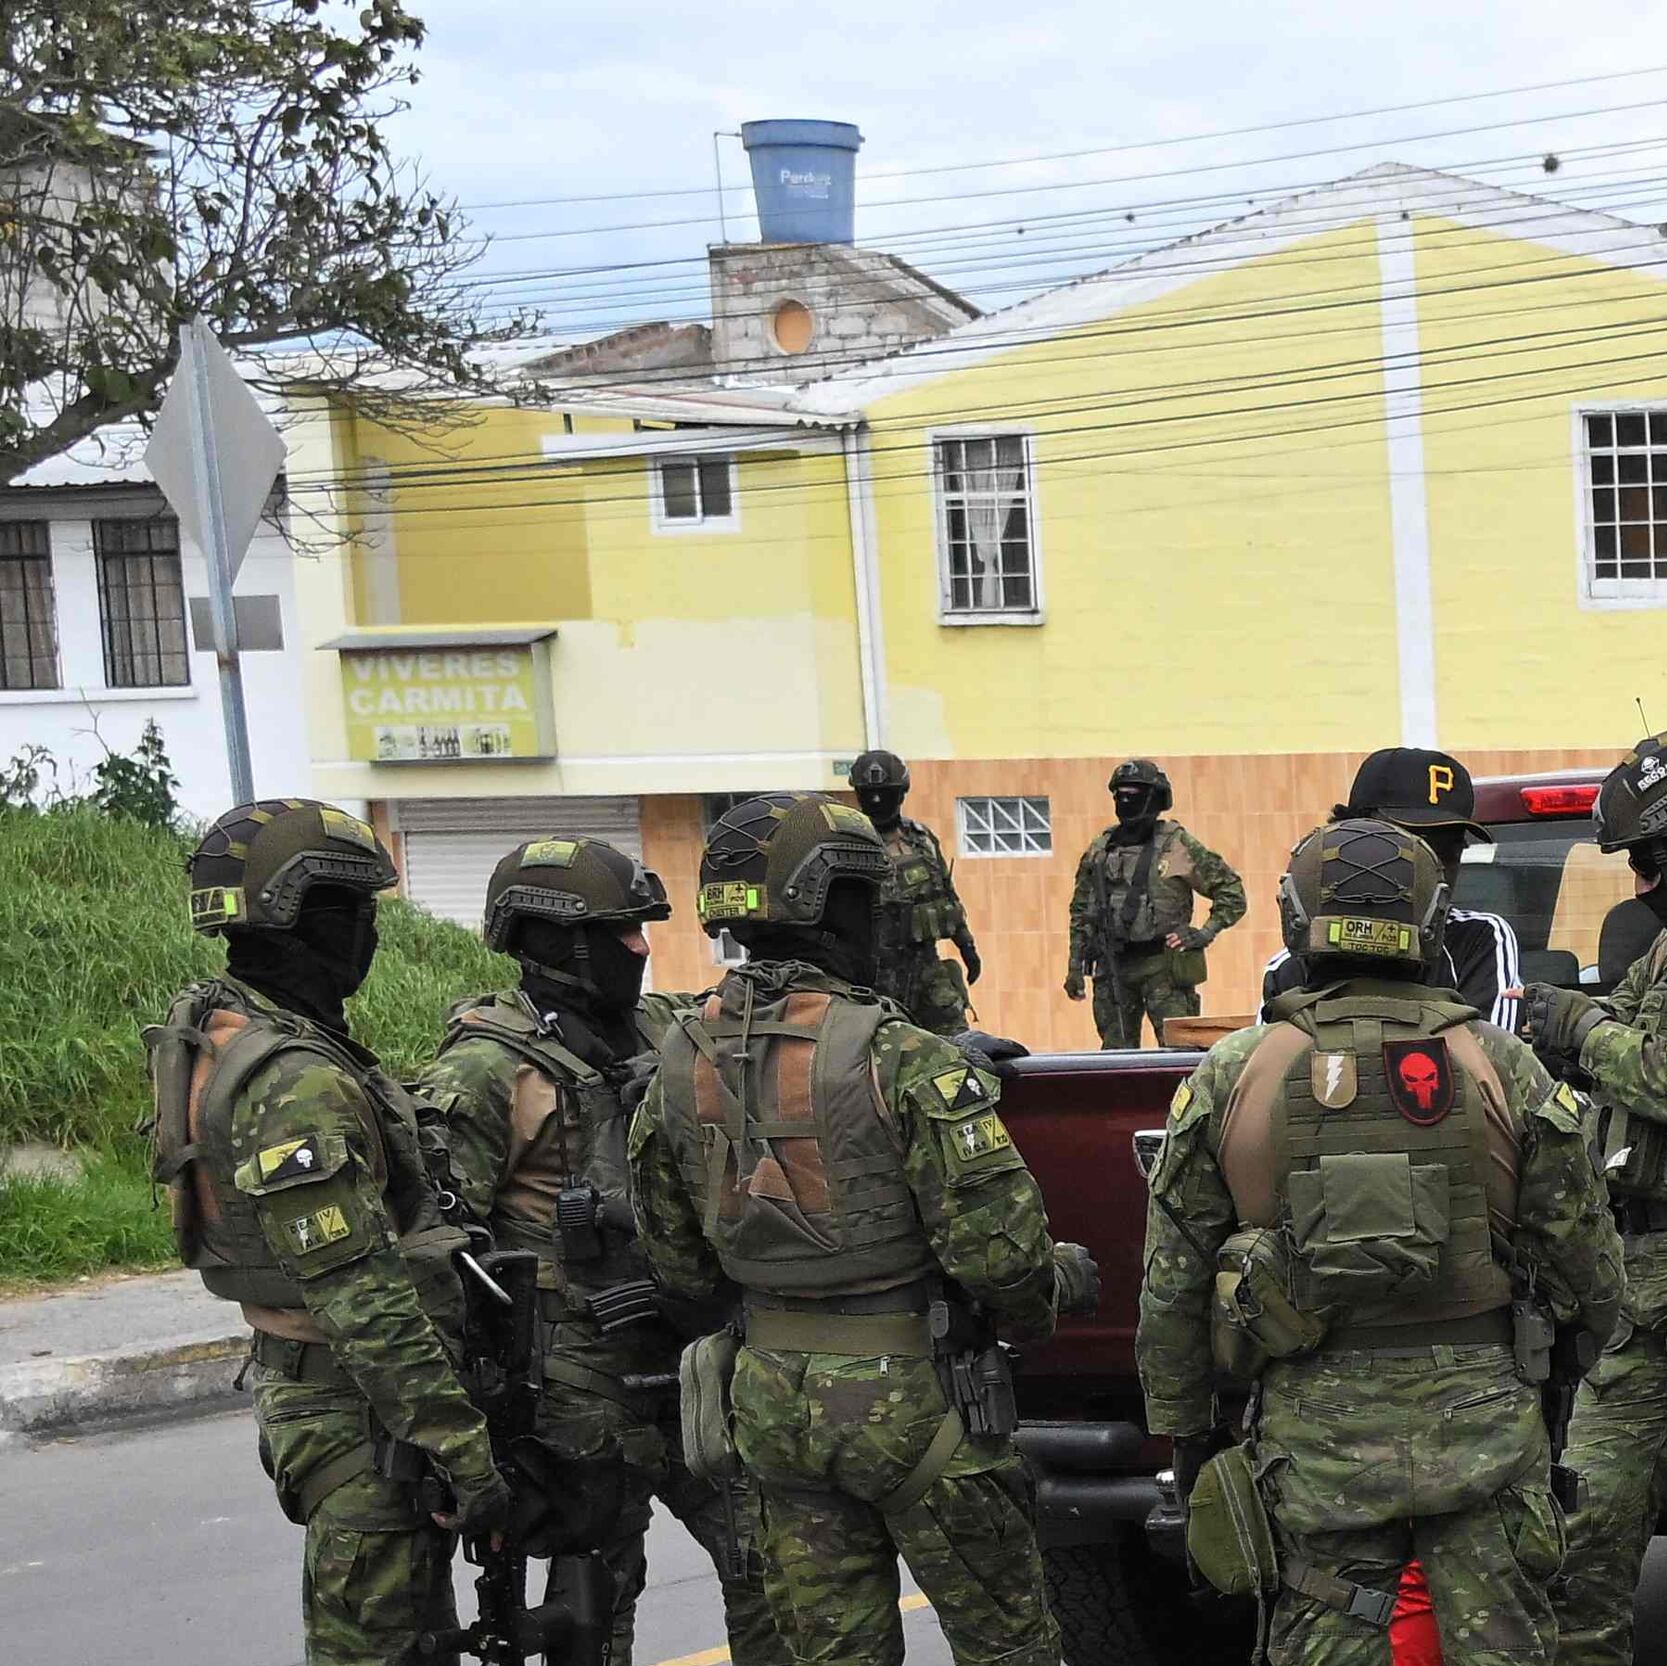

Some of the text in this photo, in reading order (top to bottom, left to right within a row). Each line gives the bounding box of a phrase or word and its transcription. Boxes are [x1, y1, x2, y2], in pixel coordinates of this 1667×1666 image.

[350, 653, 520, 681] VIVERES
[350, 684, 528, 714] CARMITA
[1428, 765, 1454, 804] P
